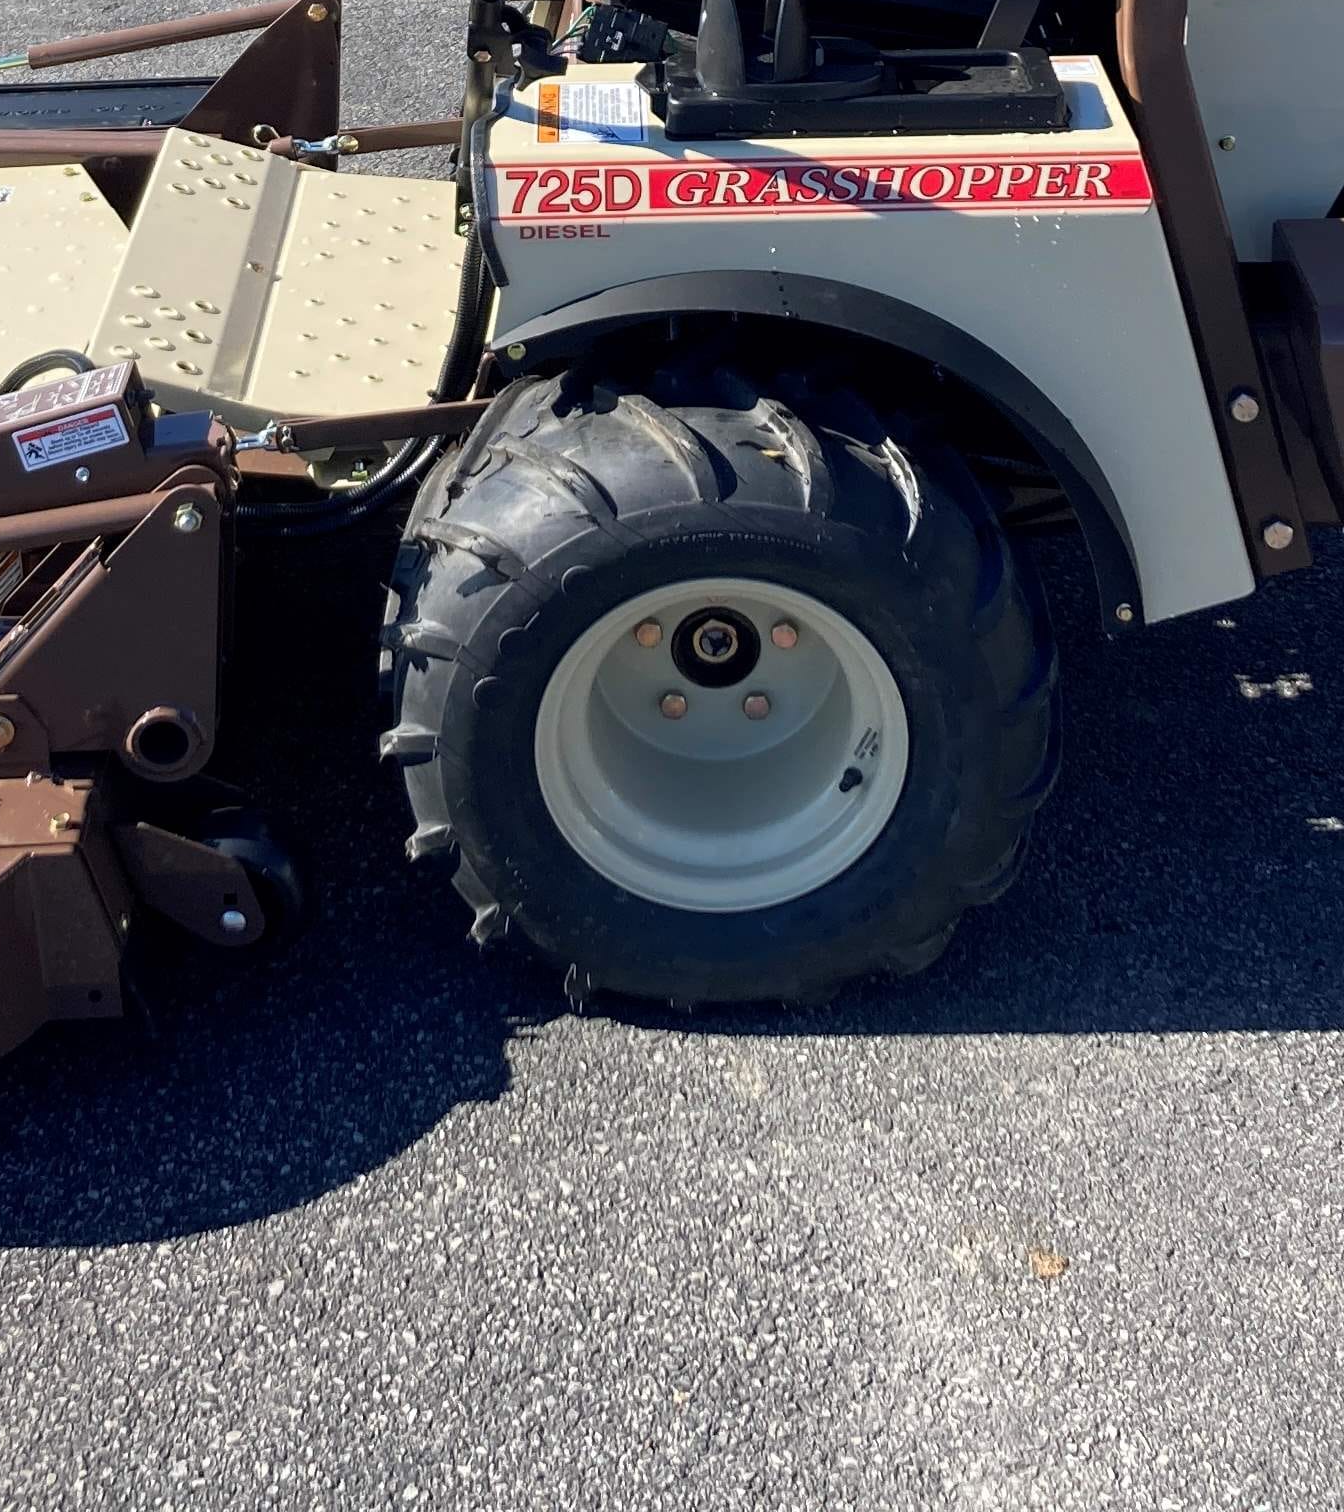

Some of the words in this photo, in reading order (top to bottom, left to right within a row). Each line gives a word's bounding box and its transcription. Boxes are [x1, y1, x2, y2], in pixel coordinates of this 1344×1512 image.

[505, 169, 642, 214] 725D
[666, 162, 1113, 206] GRASSHOPPER
[519, 225, 611, 240] DIESEL
